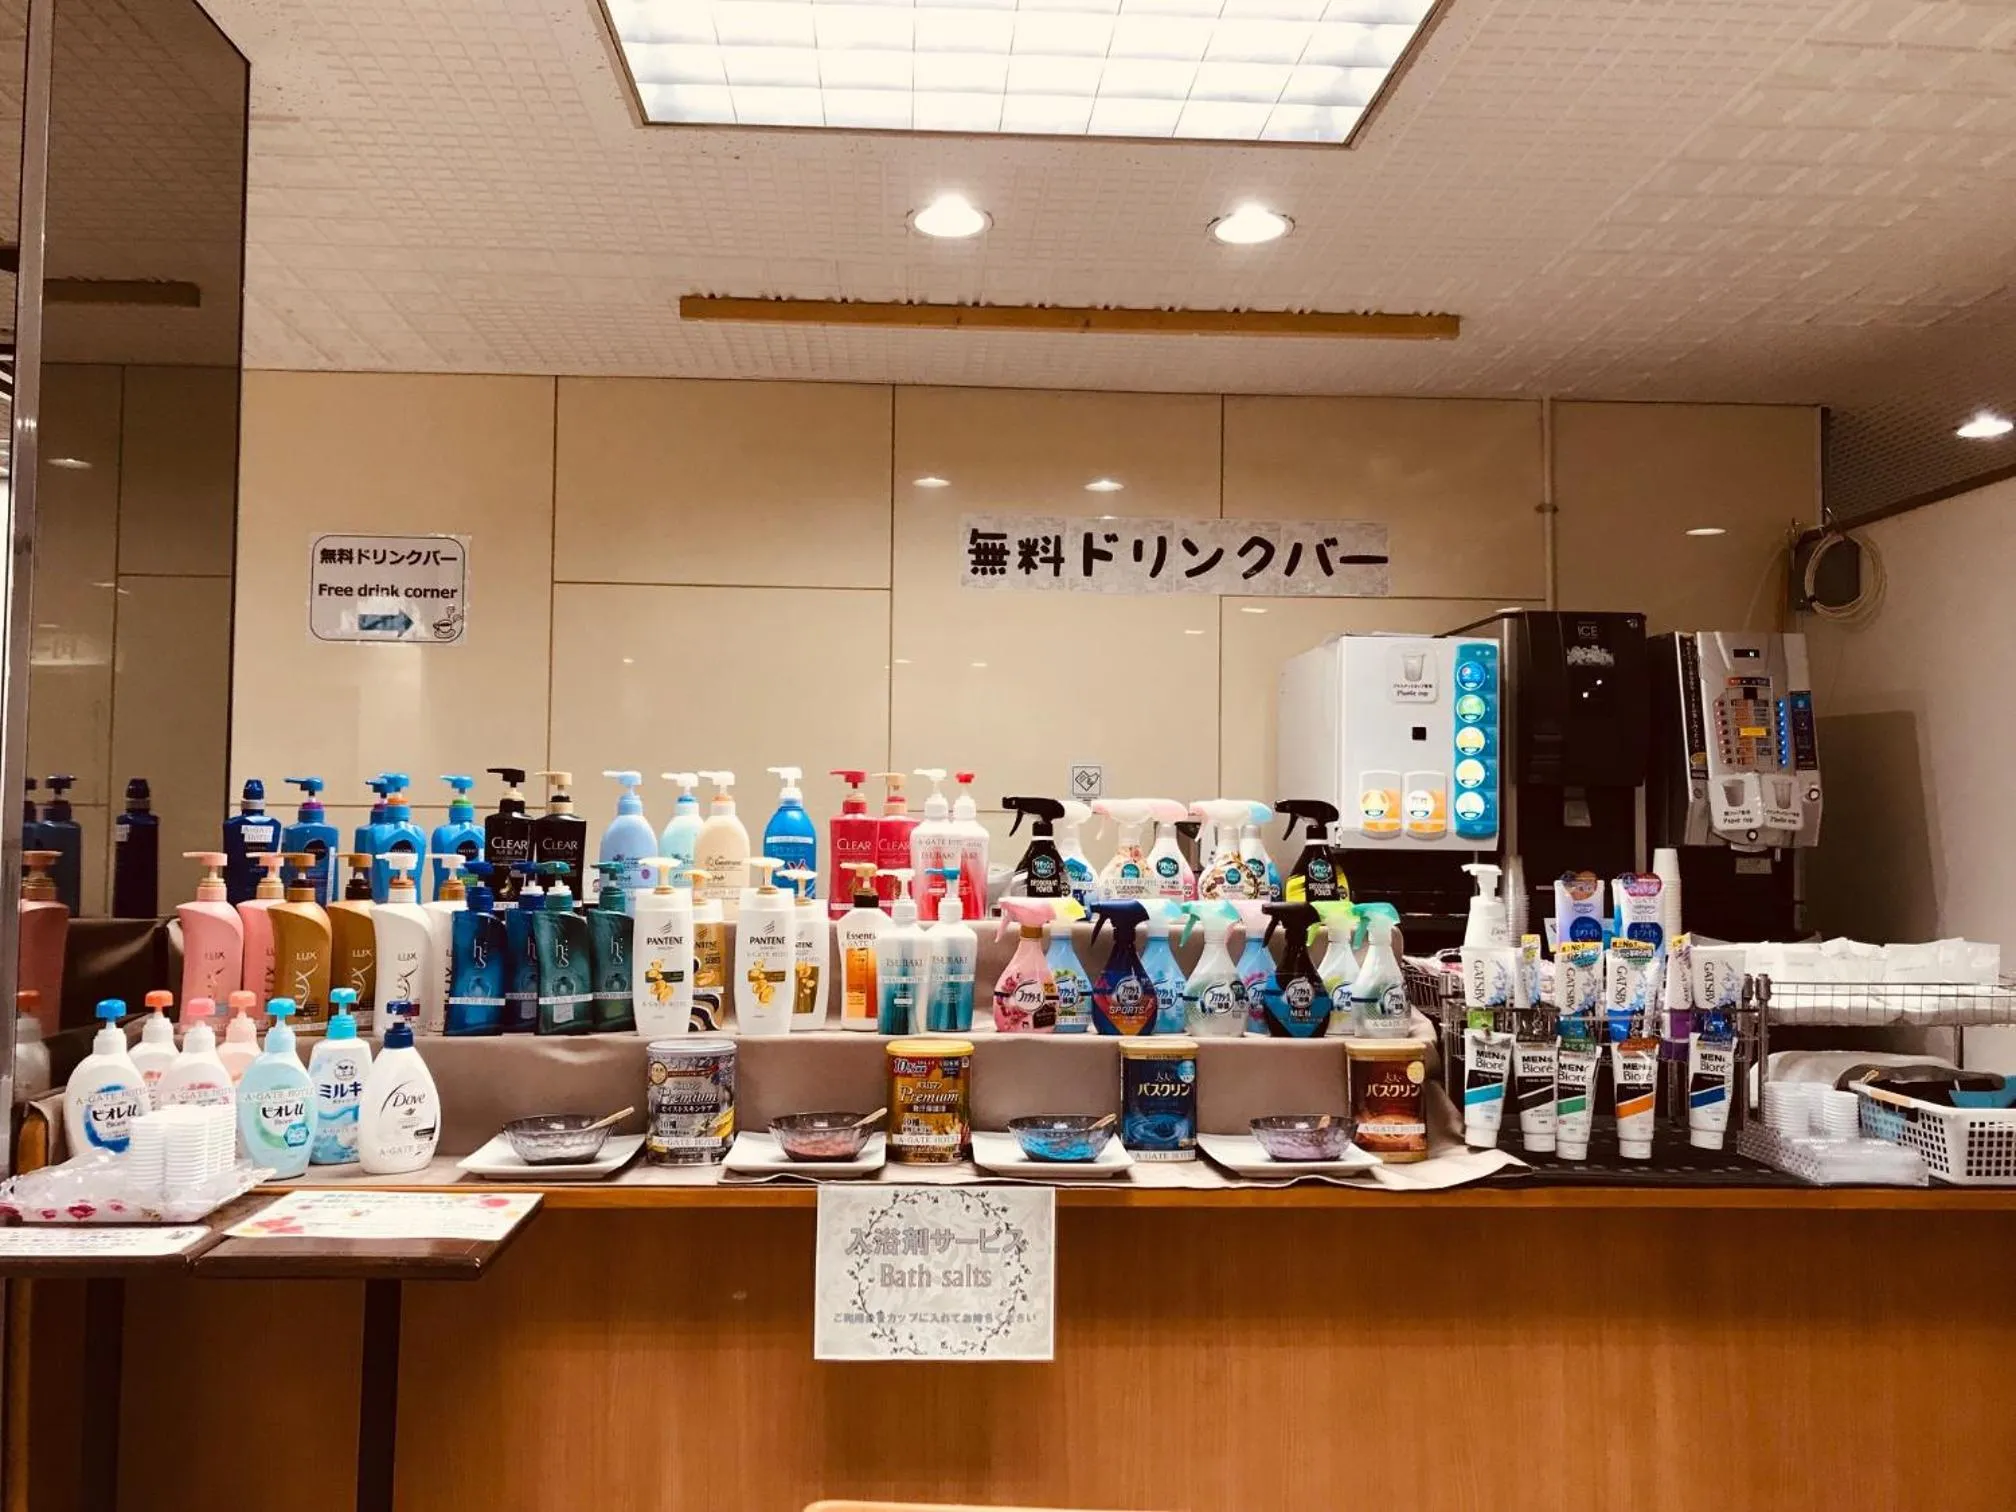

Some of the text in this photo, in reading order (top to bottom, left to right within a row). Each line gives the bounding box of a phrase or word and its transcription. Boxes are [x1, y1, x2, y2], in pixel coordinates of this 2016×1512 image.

[320, 547, 457, 566] 無料ドリンクバー
[968, 527, 1388, 579] 無料ドリンクバー
[318, 584, 457, 599] Free drink corner
[491, 836, 528, 850] CLEAR
[542, 837, 578, 850] CLEAR
[837, 837, 871, 850] CLEAR
[647, 936, 684, 945] PANTENE
[749, 936, 786, 944] PANTENE
[296, 952, 317, 960] LUX
[352, 949, 373, 957] LUX
[397, 952, 417, 961] LUX
[1474, 960, 1485, 1005] GATSBY
[1565, 967, 1576, 1010] GATSBY
[1615, 965, 1628, 1009] GATSBY
[1704, 961, 1716, 1005] GATSBY
[1109, 1006, 1145, 1014] SPORTS
[659, 1086, 719, 1105] Premium
[899, 1085, 960, 1104] Premium
[1137, 1082, 1190, 1096] バスクリン
[1366, 1083, 1420, 1097] バスクリン
[393, 1091, 425, 1107] Dove
[661, 1104, 713, 1113] モイストスキンケア
[844, 1227, 1029, 1257] 入浴剤サービス
[880, 1263, 992, 1288] Bath salts
